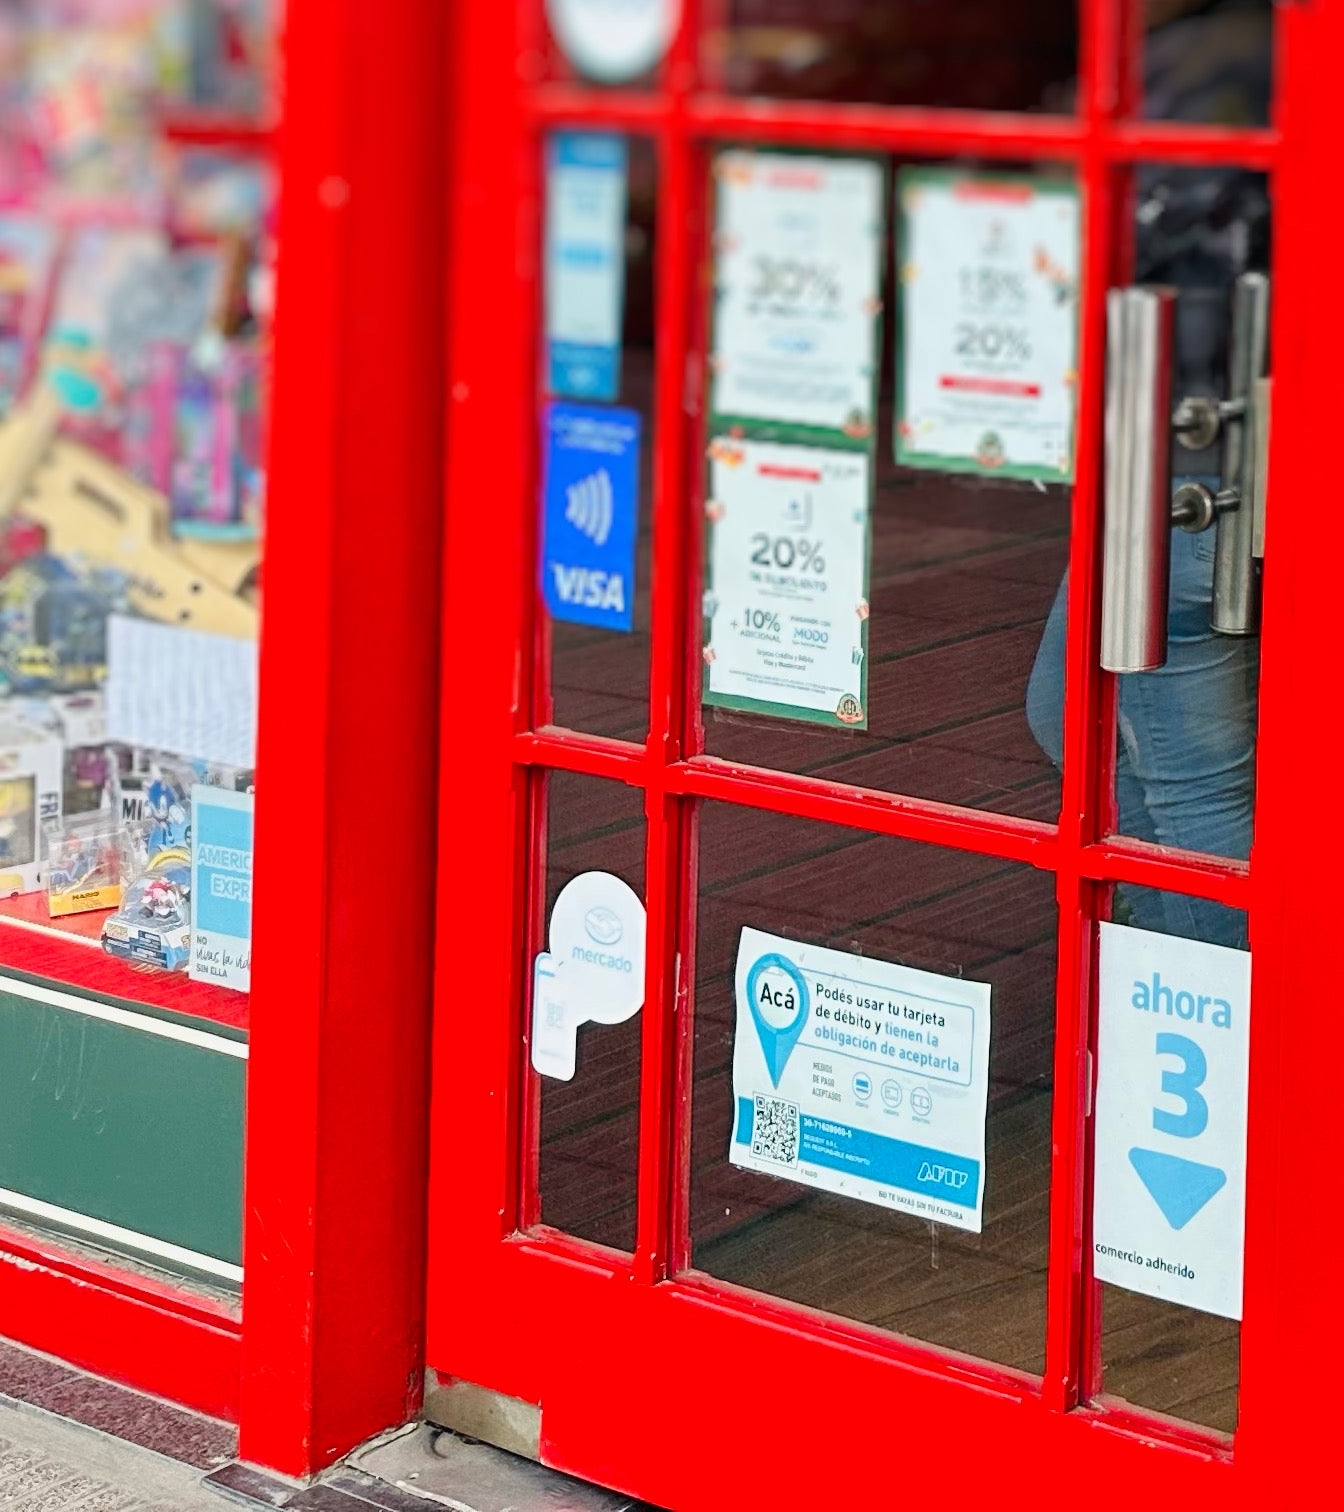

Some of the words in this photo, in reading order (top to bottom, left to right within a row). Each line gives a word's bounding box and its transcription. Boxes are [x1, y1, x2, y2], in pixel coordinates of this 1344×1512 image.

[751, 534, 826, 574] 20%
[551, 563, 625, 613] VISA
[743, 607, 781, 632] 10%
[793, 626, 829, 643] MODO
[211, 873, 250, 902] EXPR
[196, 935, 208, 945] NO
[196, 963, 209, 974] SIN
[211, 966, 228, 978] ELLA
[570, 945, 633, 975] mercado
[760, 982, 795, 1010] Acá
[816, 983, 853, 1006] Podés
[856, 996, 884, 1012] usar
[887, 1000, 900, 1016] tu
[903, 1004, 946, 1028] tarjeta
[1131, 972, 1232, 1030] ahora
[816, 1004, 830, 1019] de
[834, 1007, 871, 1030] débito
[875, 1021, 882, 1035] y
[884, 1021, 923, 1044] tienen
[926, 1032, 939, 1048] la
[814, 1025, 877, 1052] obligación
[880, 1040, 896, 1057] de
[899, 1047, 960, 1074] aceptarla
[1151, 1032, 1210, 1139] 3
[917, 1162, 968, 1189] AFIP
[1095, 1241, 1143, 1267] comercio
[1145, 1253, 1196, 1281] adherido
